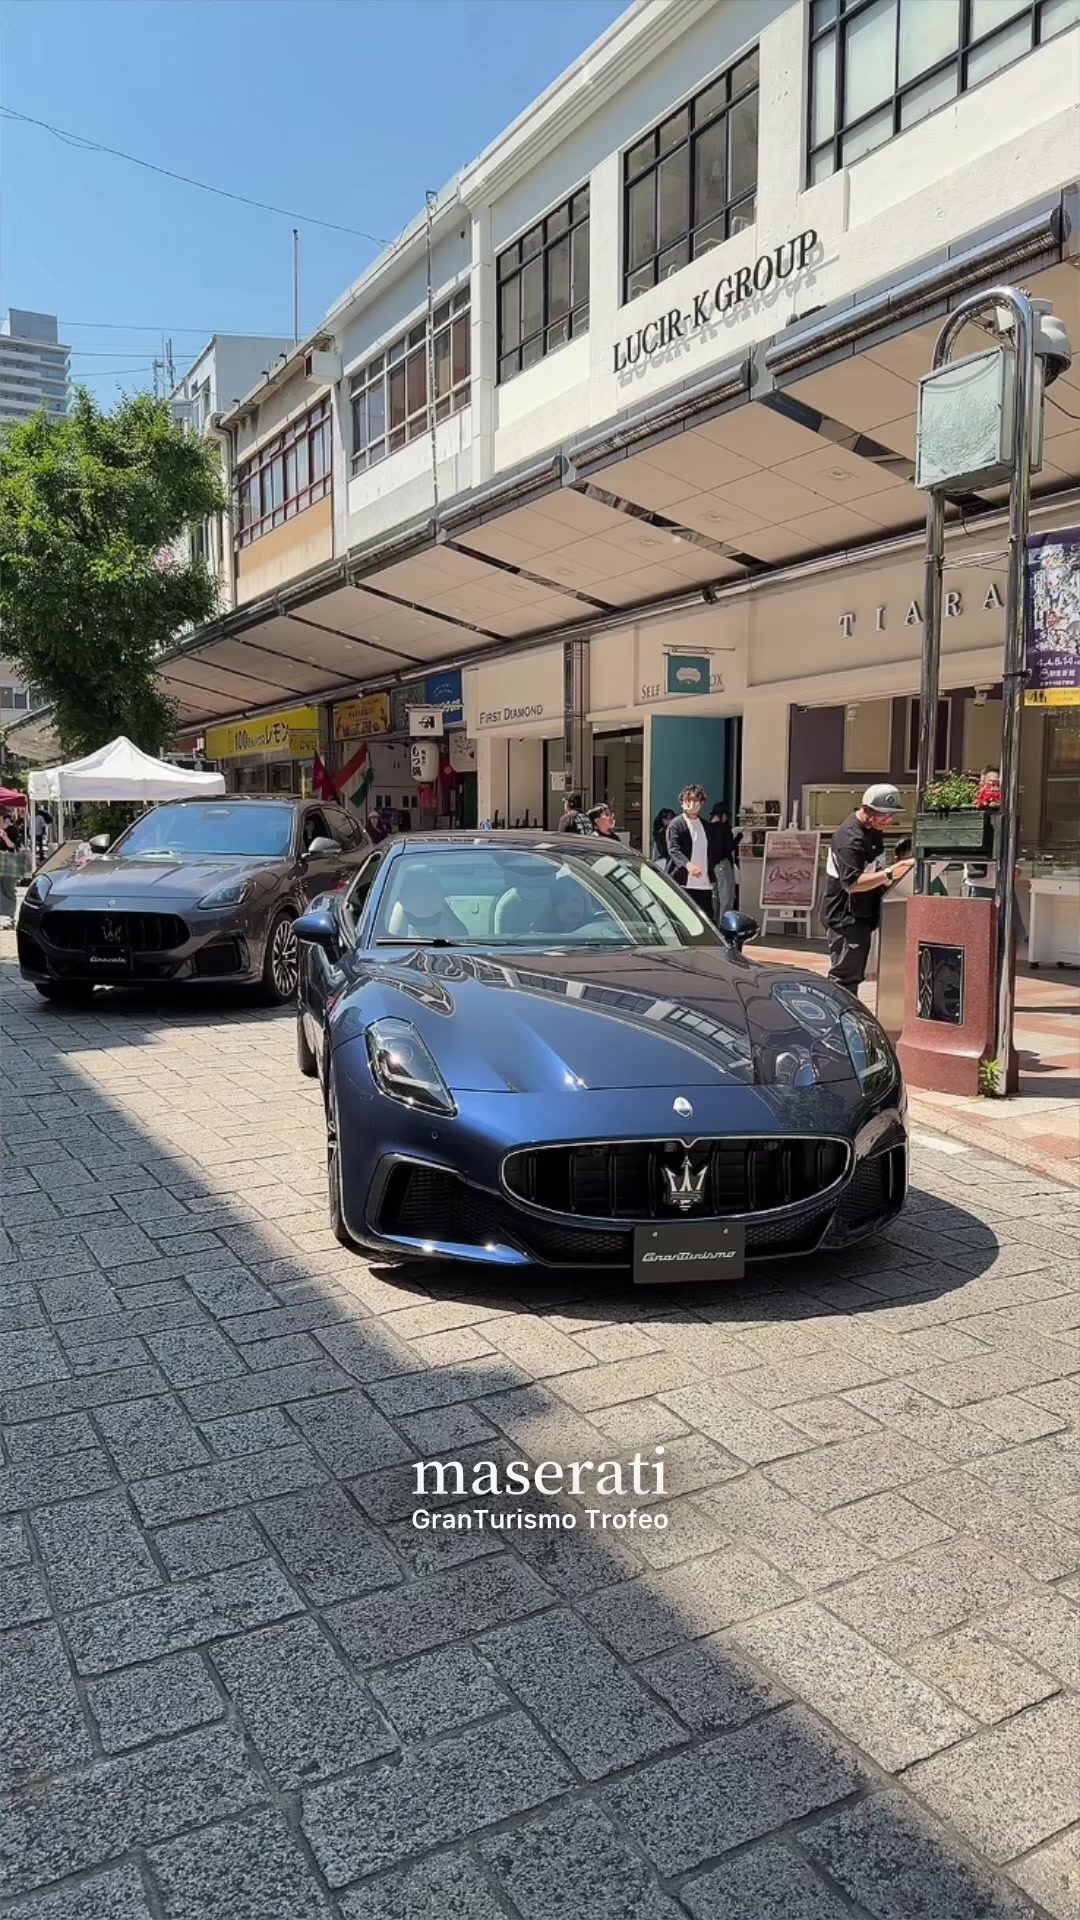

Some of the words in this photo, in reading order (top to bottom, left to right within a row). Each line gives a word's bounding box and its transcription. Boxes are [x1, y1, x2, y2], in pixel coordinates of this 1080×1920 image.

[613, 289, 710, 374] LUCIR-K
[715, 229, 818, 312] GROUP
[838, 583, 1004, 638] TIARA
[641, 684, 661, 699] SELF
[479, 710, 502, 724] FIRST
[504, 704, 543, 720] DIAMOND
[642, 1251, 736, 1262] GranTurismo
